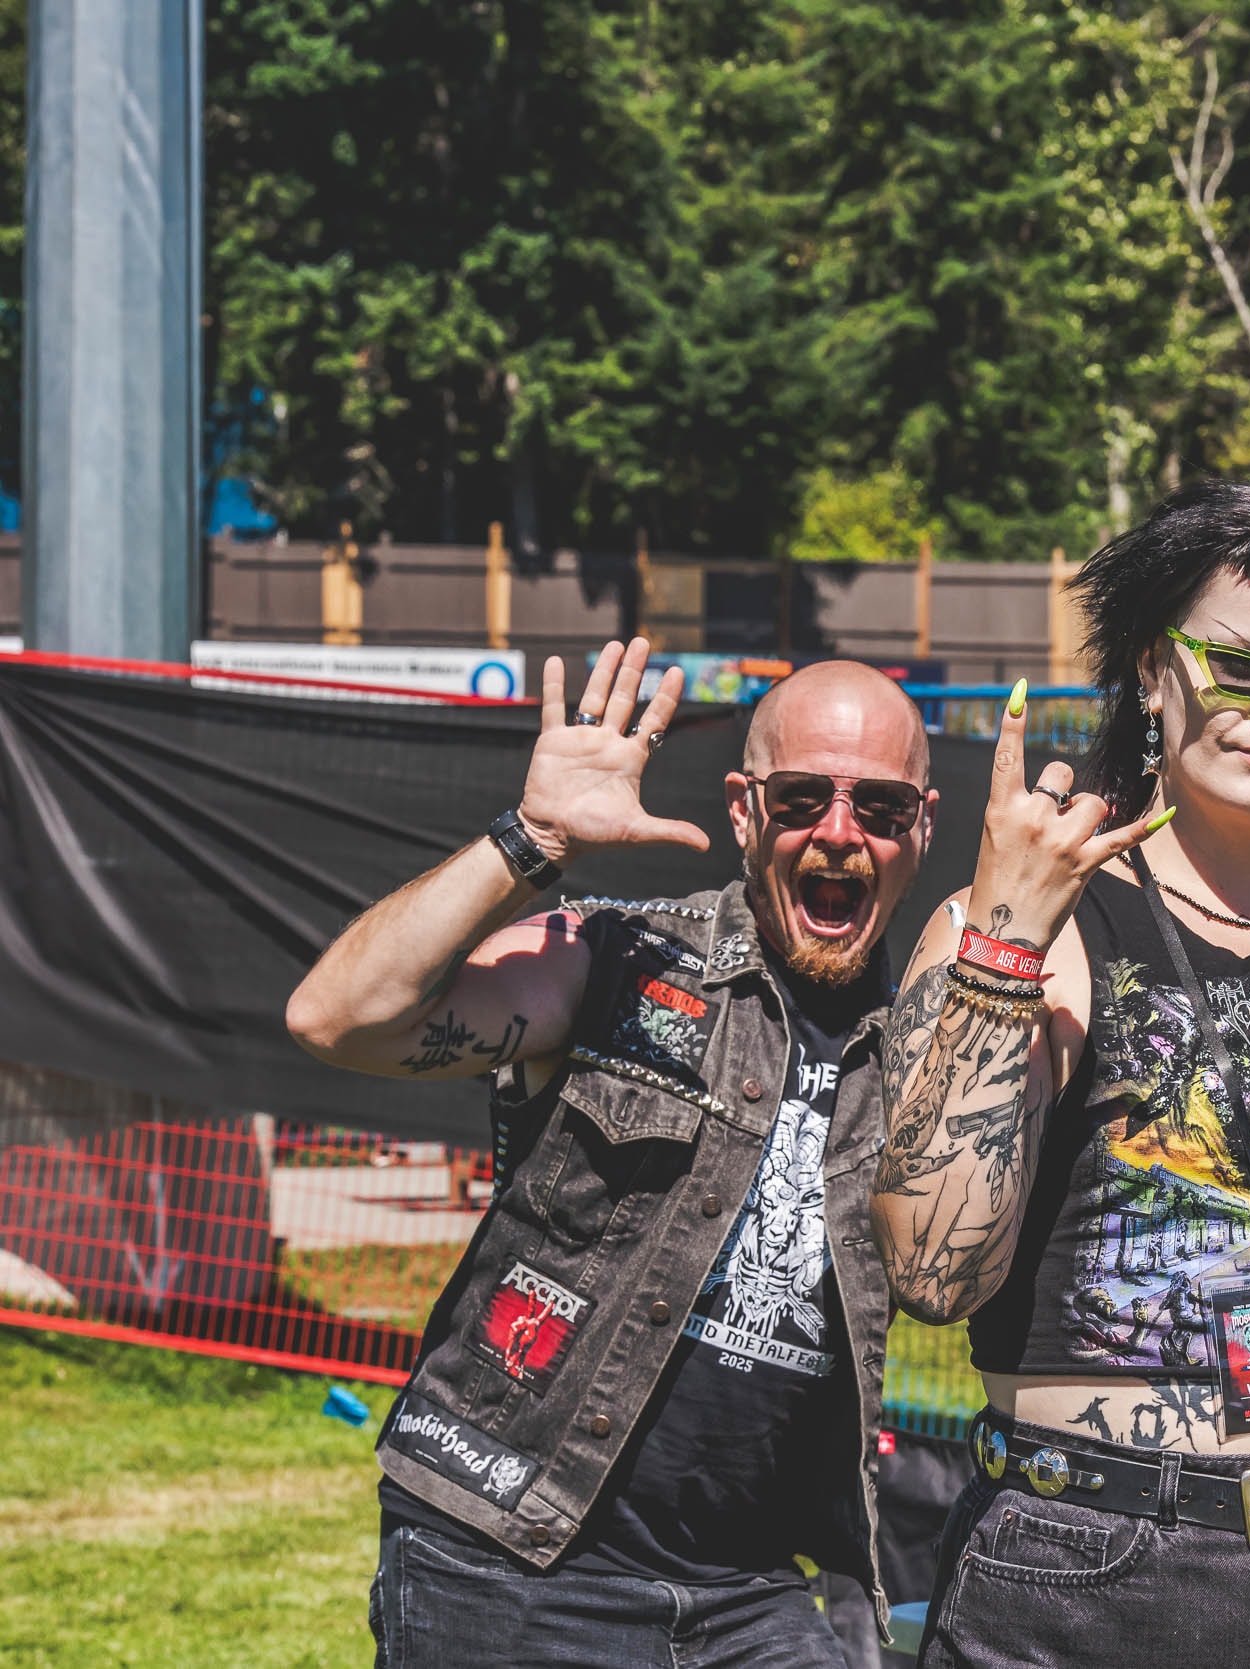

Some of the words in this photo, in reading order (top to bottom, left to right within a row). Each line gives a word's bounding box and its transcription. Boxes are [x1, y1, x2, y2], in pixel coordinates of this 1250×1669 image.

[996, 950, 1018, 970] AGE
[500, 1261, 588, 1324] ACCEPT
[718, 1352, 754, 1373] 2025
[725, 1329, 823, 1369] METALFES
